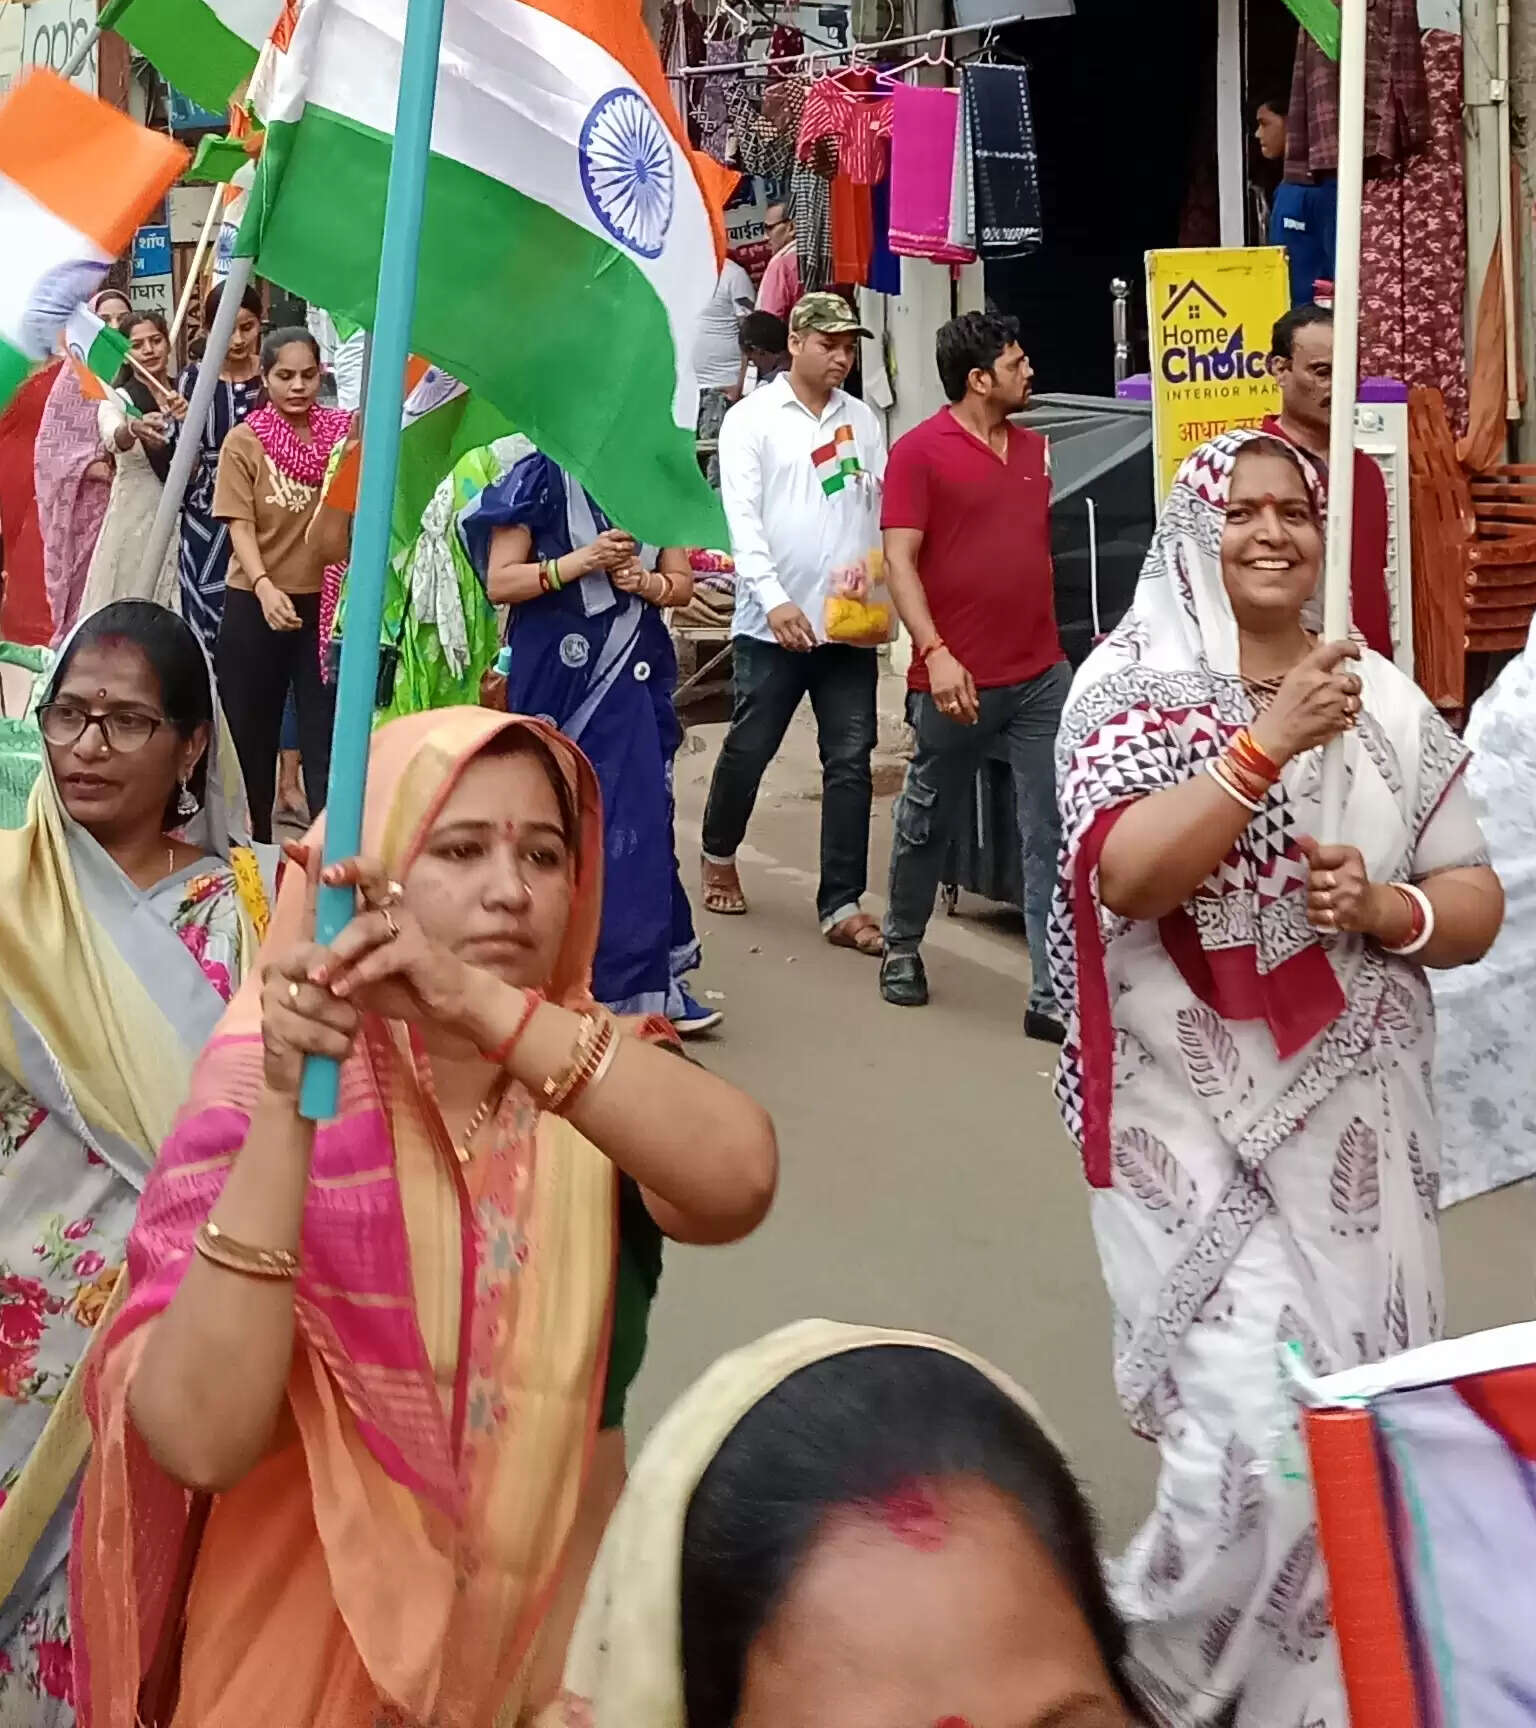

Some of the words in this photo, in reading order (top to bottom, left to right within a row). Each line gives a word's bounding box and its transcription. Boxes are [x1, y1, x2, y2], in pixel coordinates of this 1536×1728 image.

[1162, 325, 1229, 346] Home
[1166, 385, 1240, 401] INTERIOR
[1248, 381, 1280, 397] MAR
